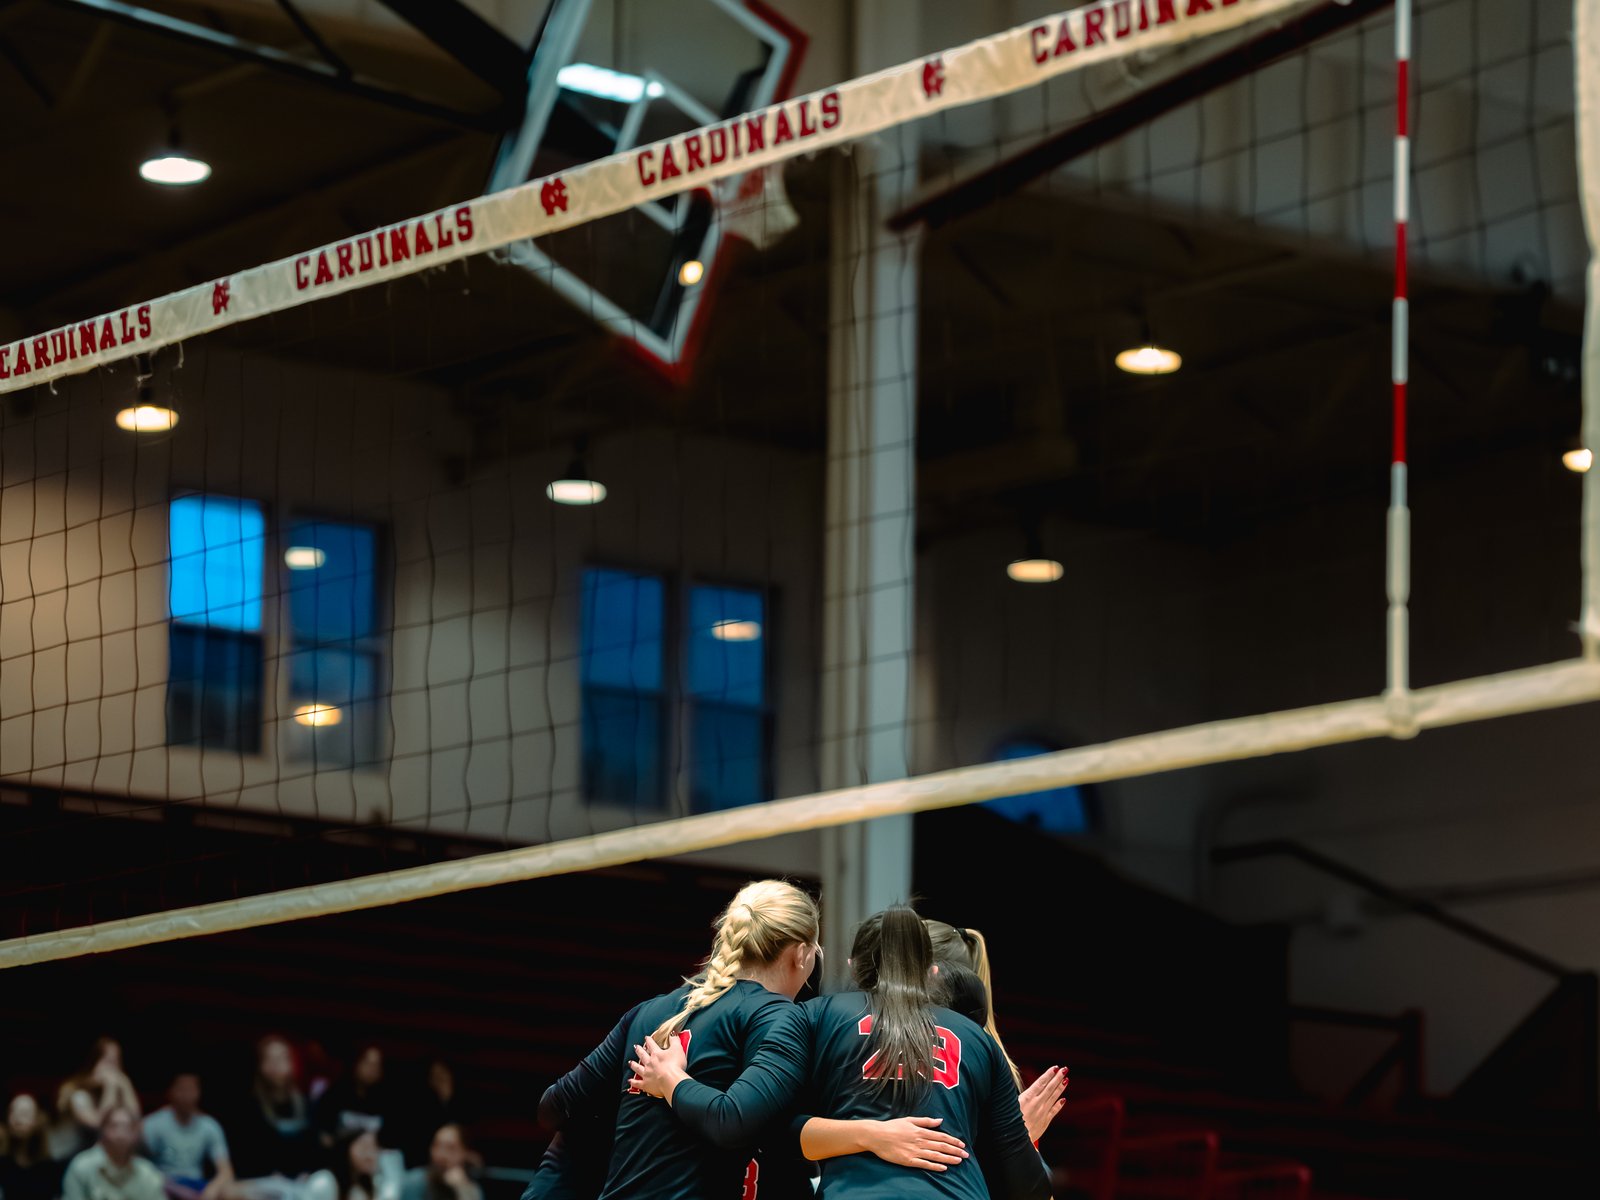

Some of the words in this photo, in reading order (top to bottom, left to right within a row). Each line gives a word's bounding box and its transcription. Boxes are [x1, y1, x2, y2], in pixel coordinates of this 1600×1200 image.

[0, 305, 152, 380] CARDINALS
[295, 206, 474, 290] CARDINALS
[637, 92, 841, 187] CARDINALS
